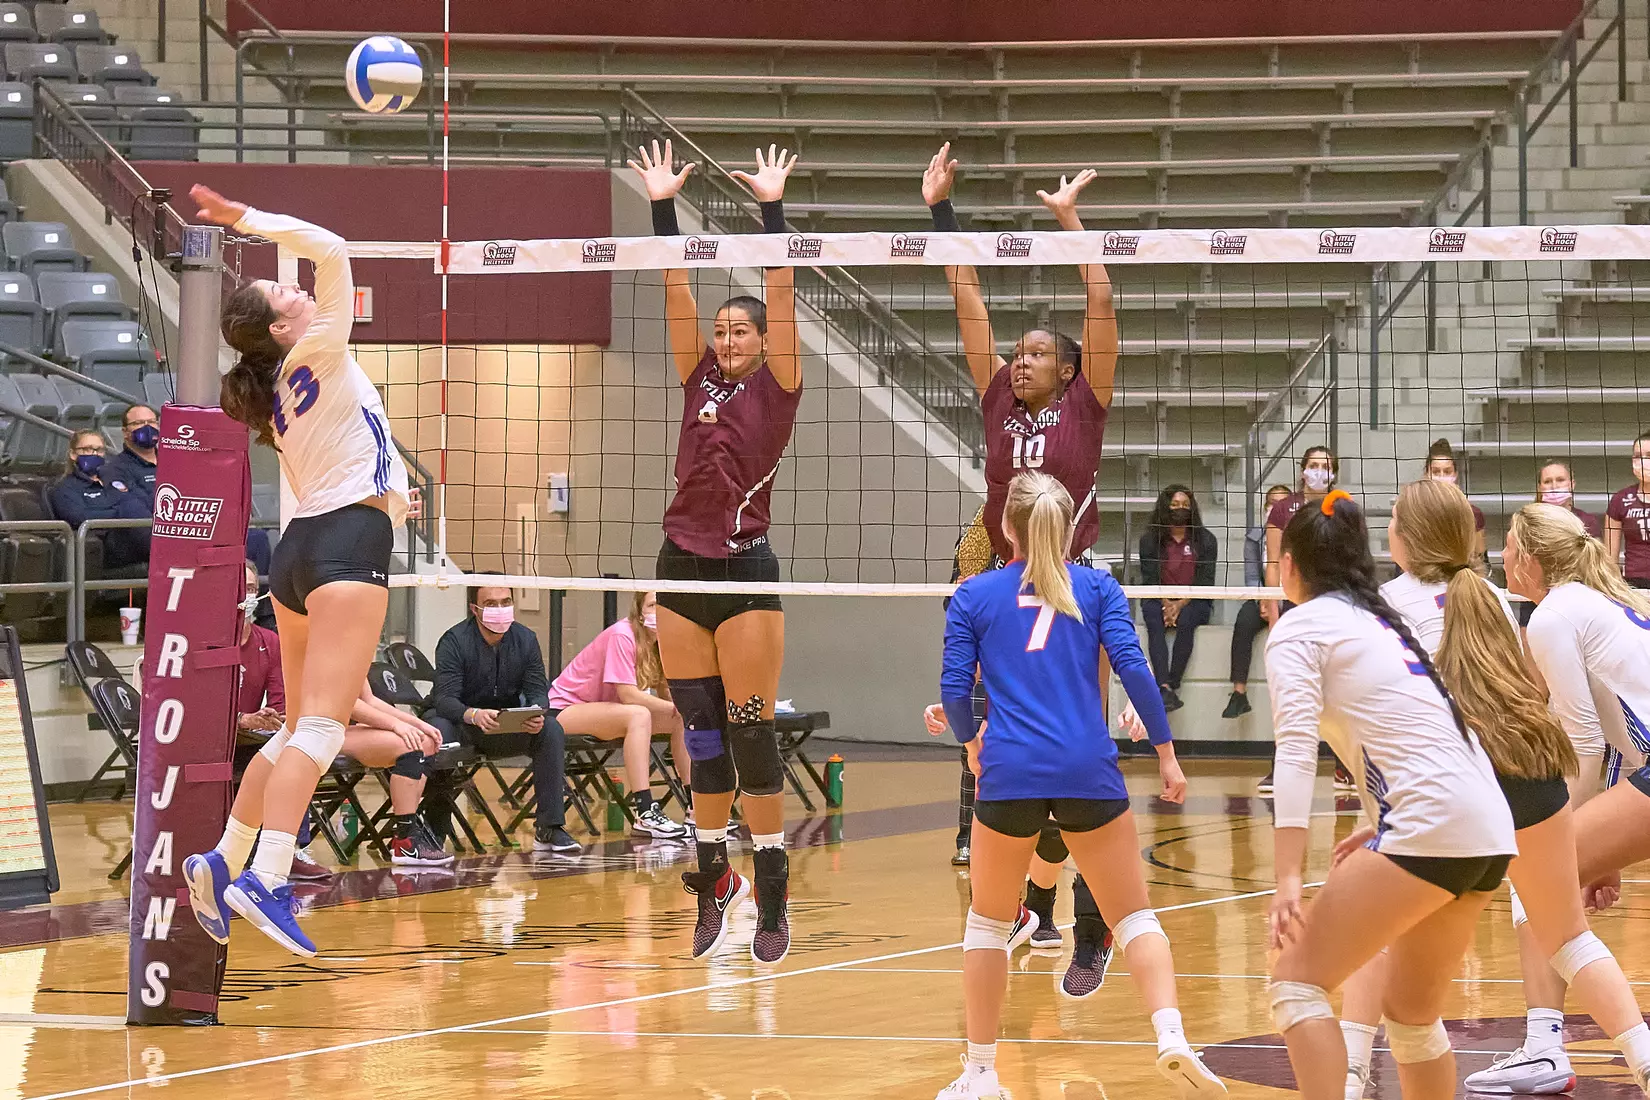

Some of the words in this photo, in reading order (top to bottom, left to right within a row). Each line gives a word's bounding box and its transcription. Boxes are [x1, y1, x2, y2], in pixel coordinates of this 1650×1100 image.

[271, 364, 320, 438] 13
[1010, 433, 1046, 469] 10
[174, 512, 215, 524] ROCK
[177, 500, 219, 513] LITTLE
[154, 525, 208, 537] VOLLEYBALL
[1016, 594, 1057, 652] 7
[141, 567, 196, 1008] TROJANS
